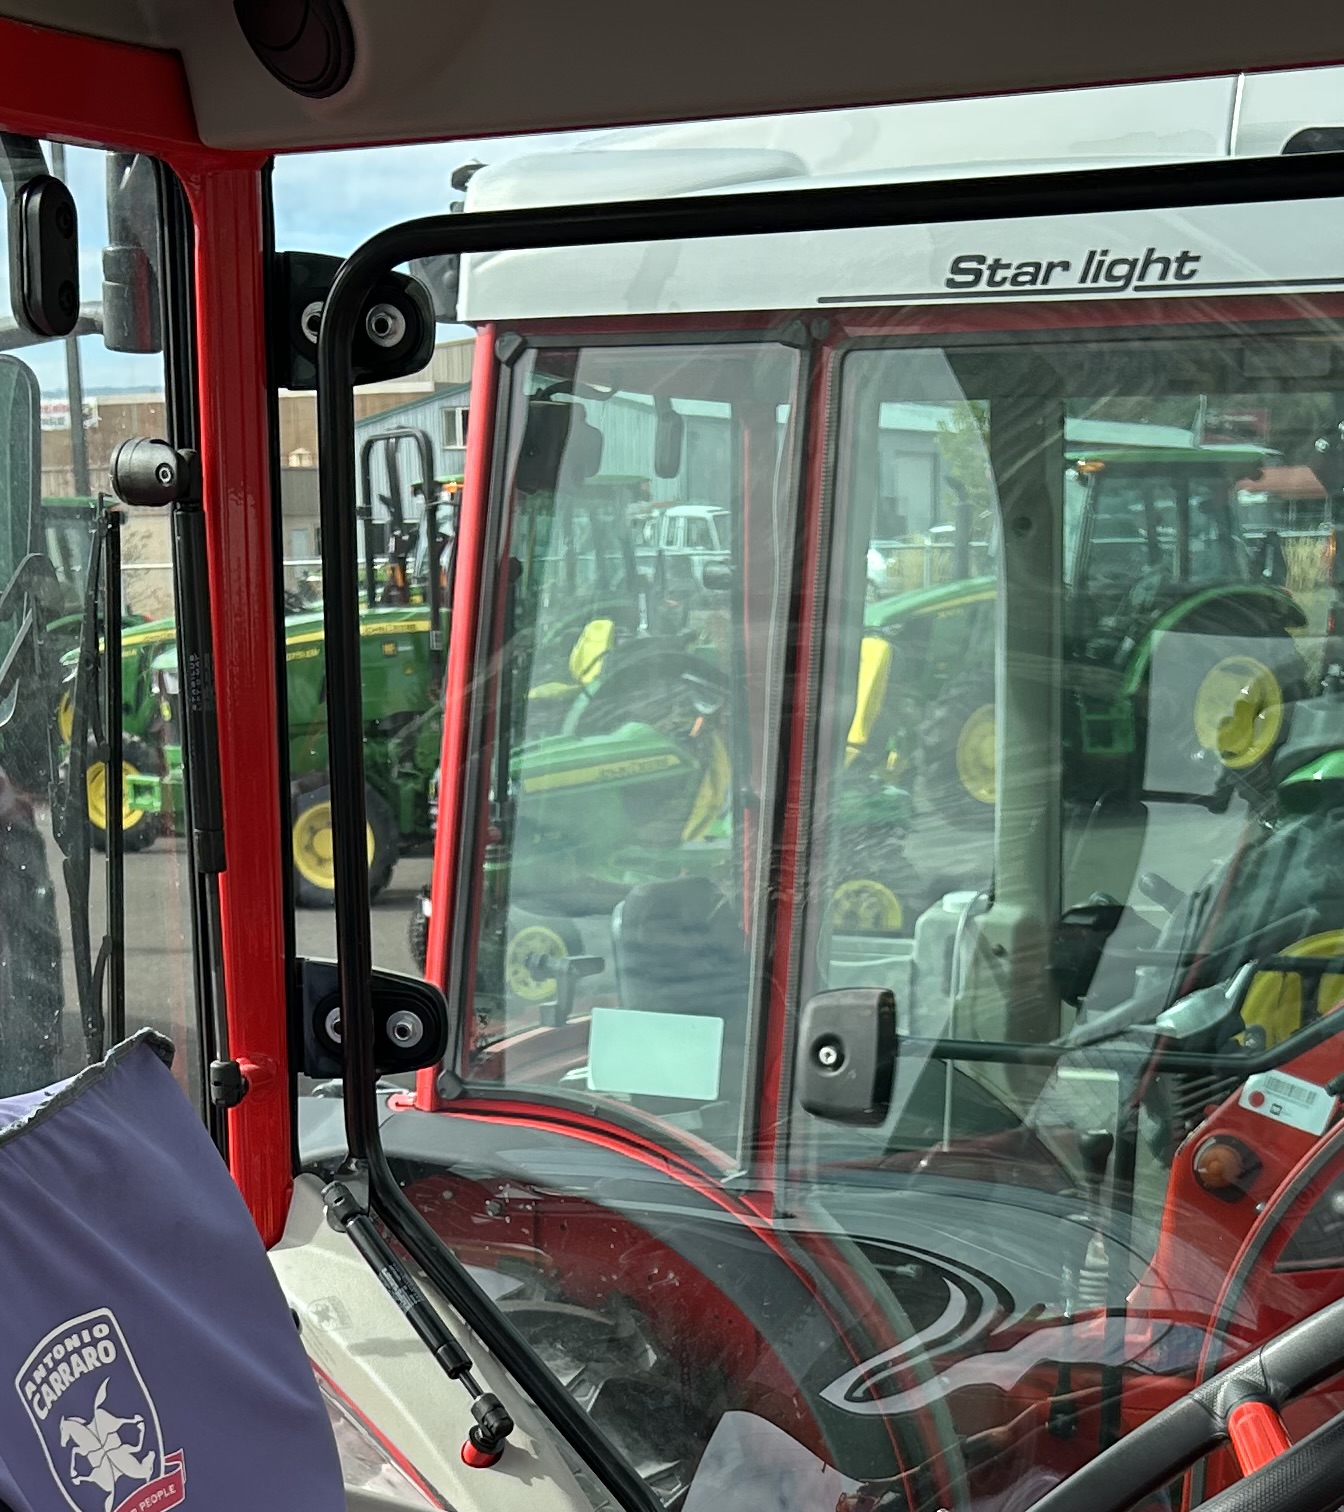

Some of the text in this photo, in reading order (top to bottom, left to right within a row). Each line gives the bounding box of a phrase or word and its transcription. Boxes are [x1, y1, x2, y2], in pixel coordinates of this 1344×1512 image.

[945, 247, 1202, 292] Star light
[24, 1323, 110, 1400] ANTONIO
[32, 1339, 116, 1420] CARRARO
[139, 1483, 177, 1512] PEOPLE
